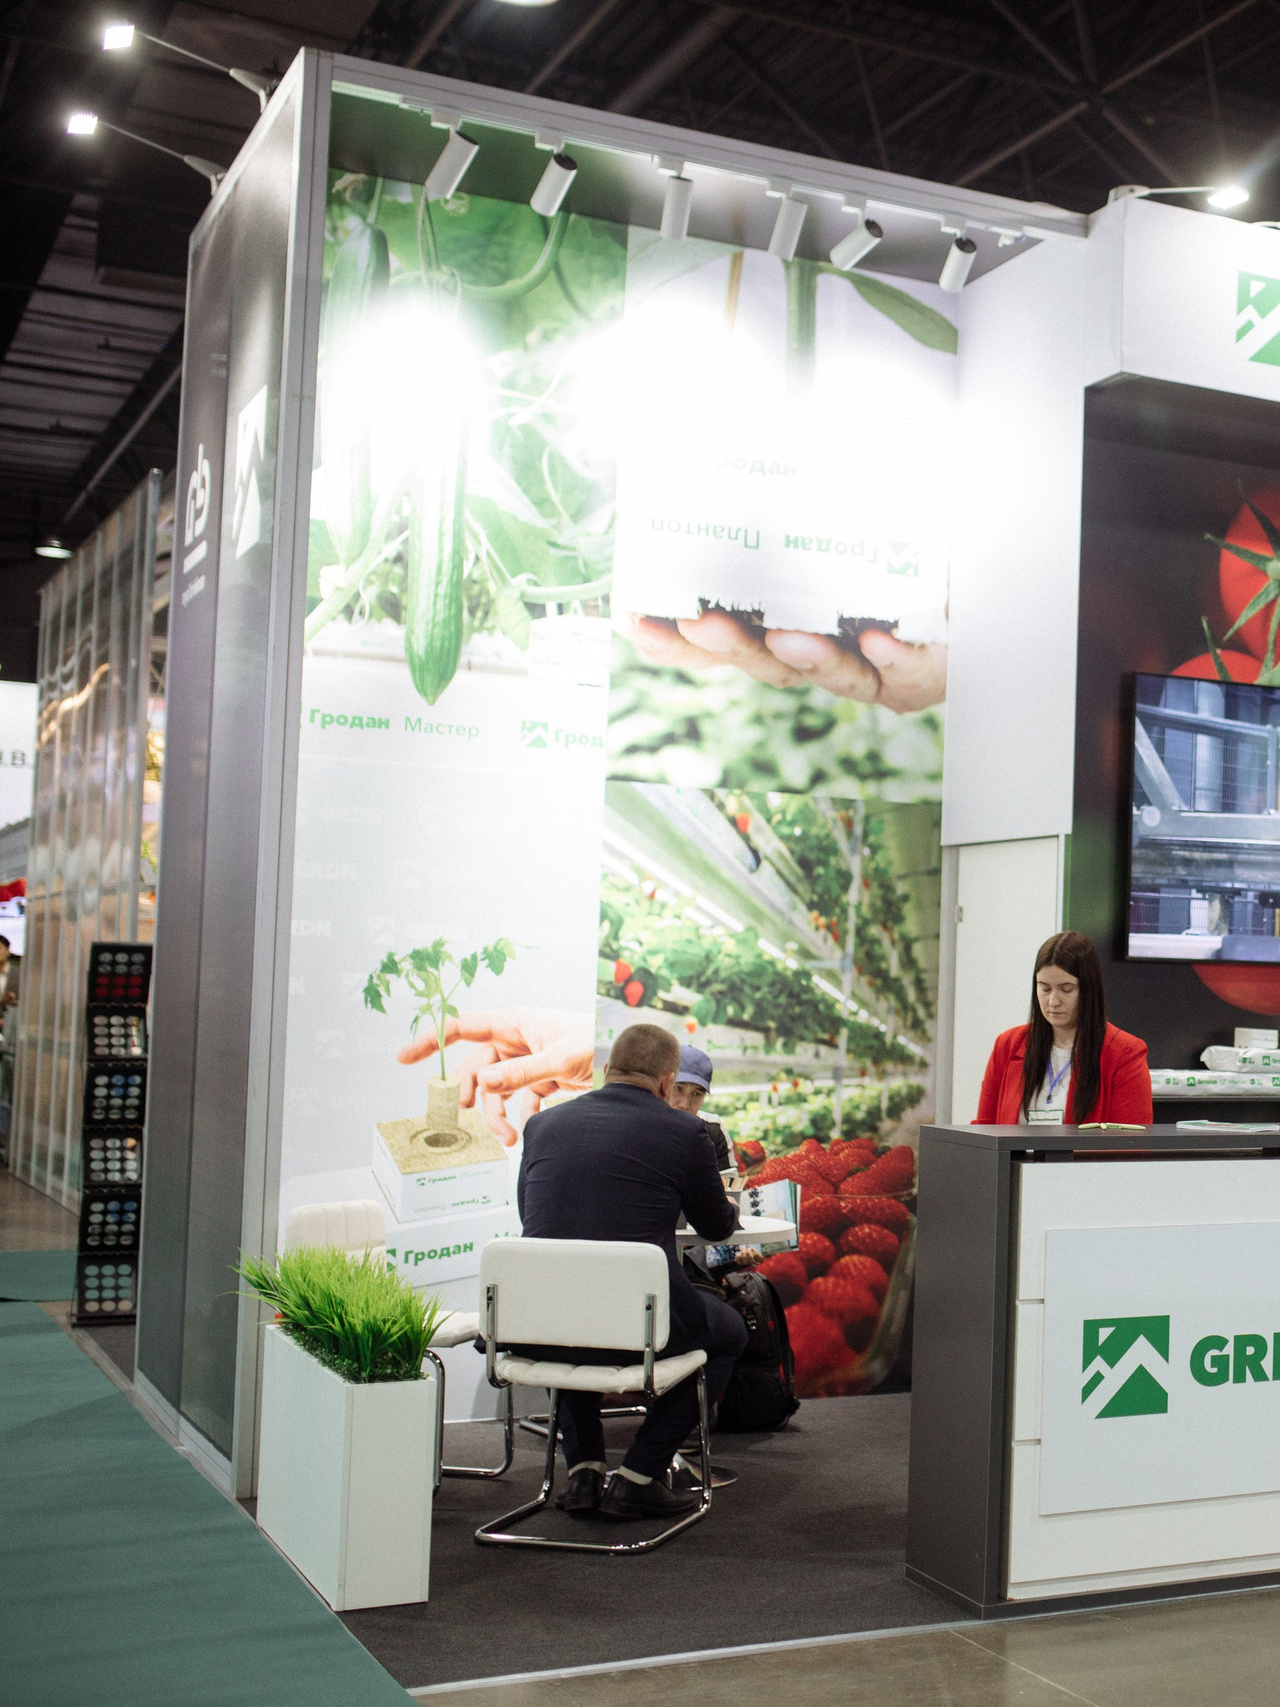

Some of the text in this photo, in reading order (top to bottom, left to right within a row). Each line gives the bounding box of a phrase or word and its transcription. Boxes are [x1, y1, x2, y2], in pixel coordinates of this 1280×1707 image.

[651, 516, 760, 549] Плантоп
[308, 708, 481, 741] Гродан Мастер
[403, 1241, 475, 1267] Гродан
